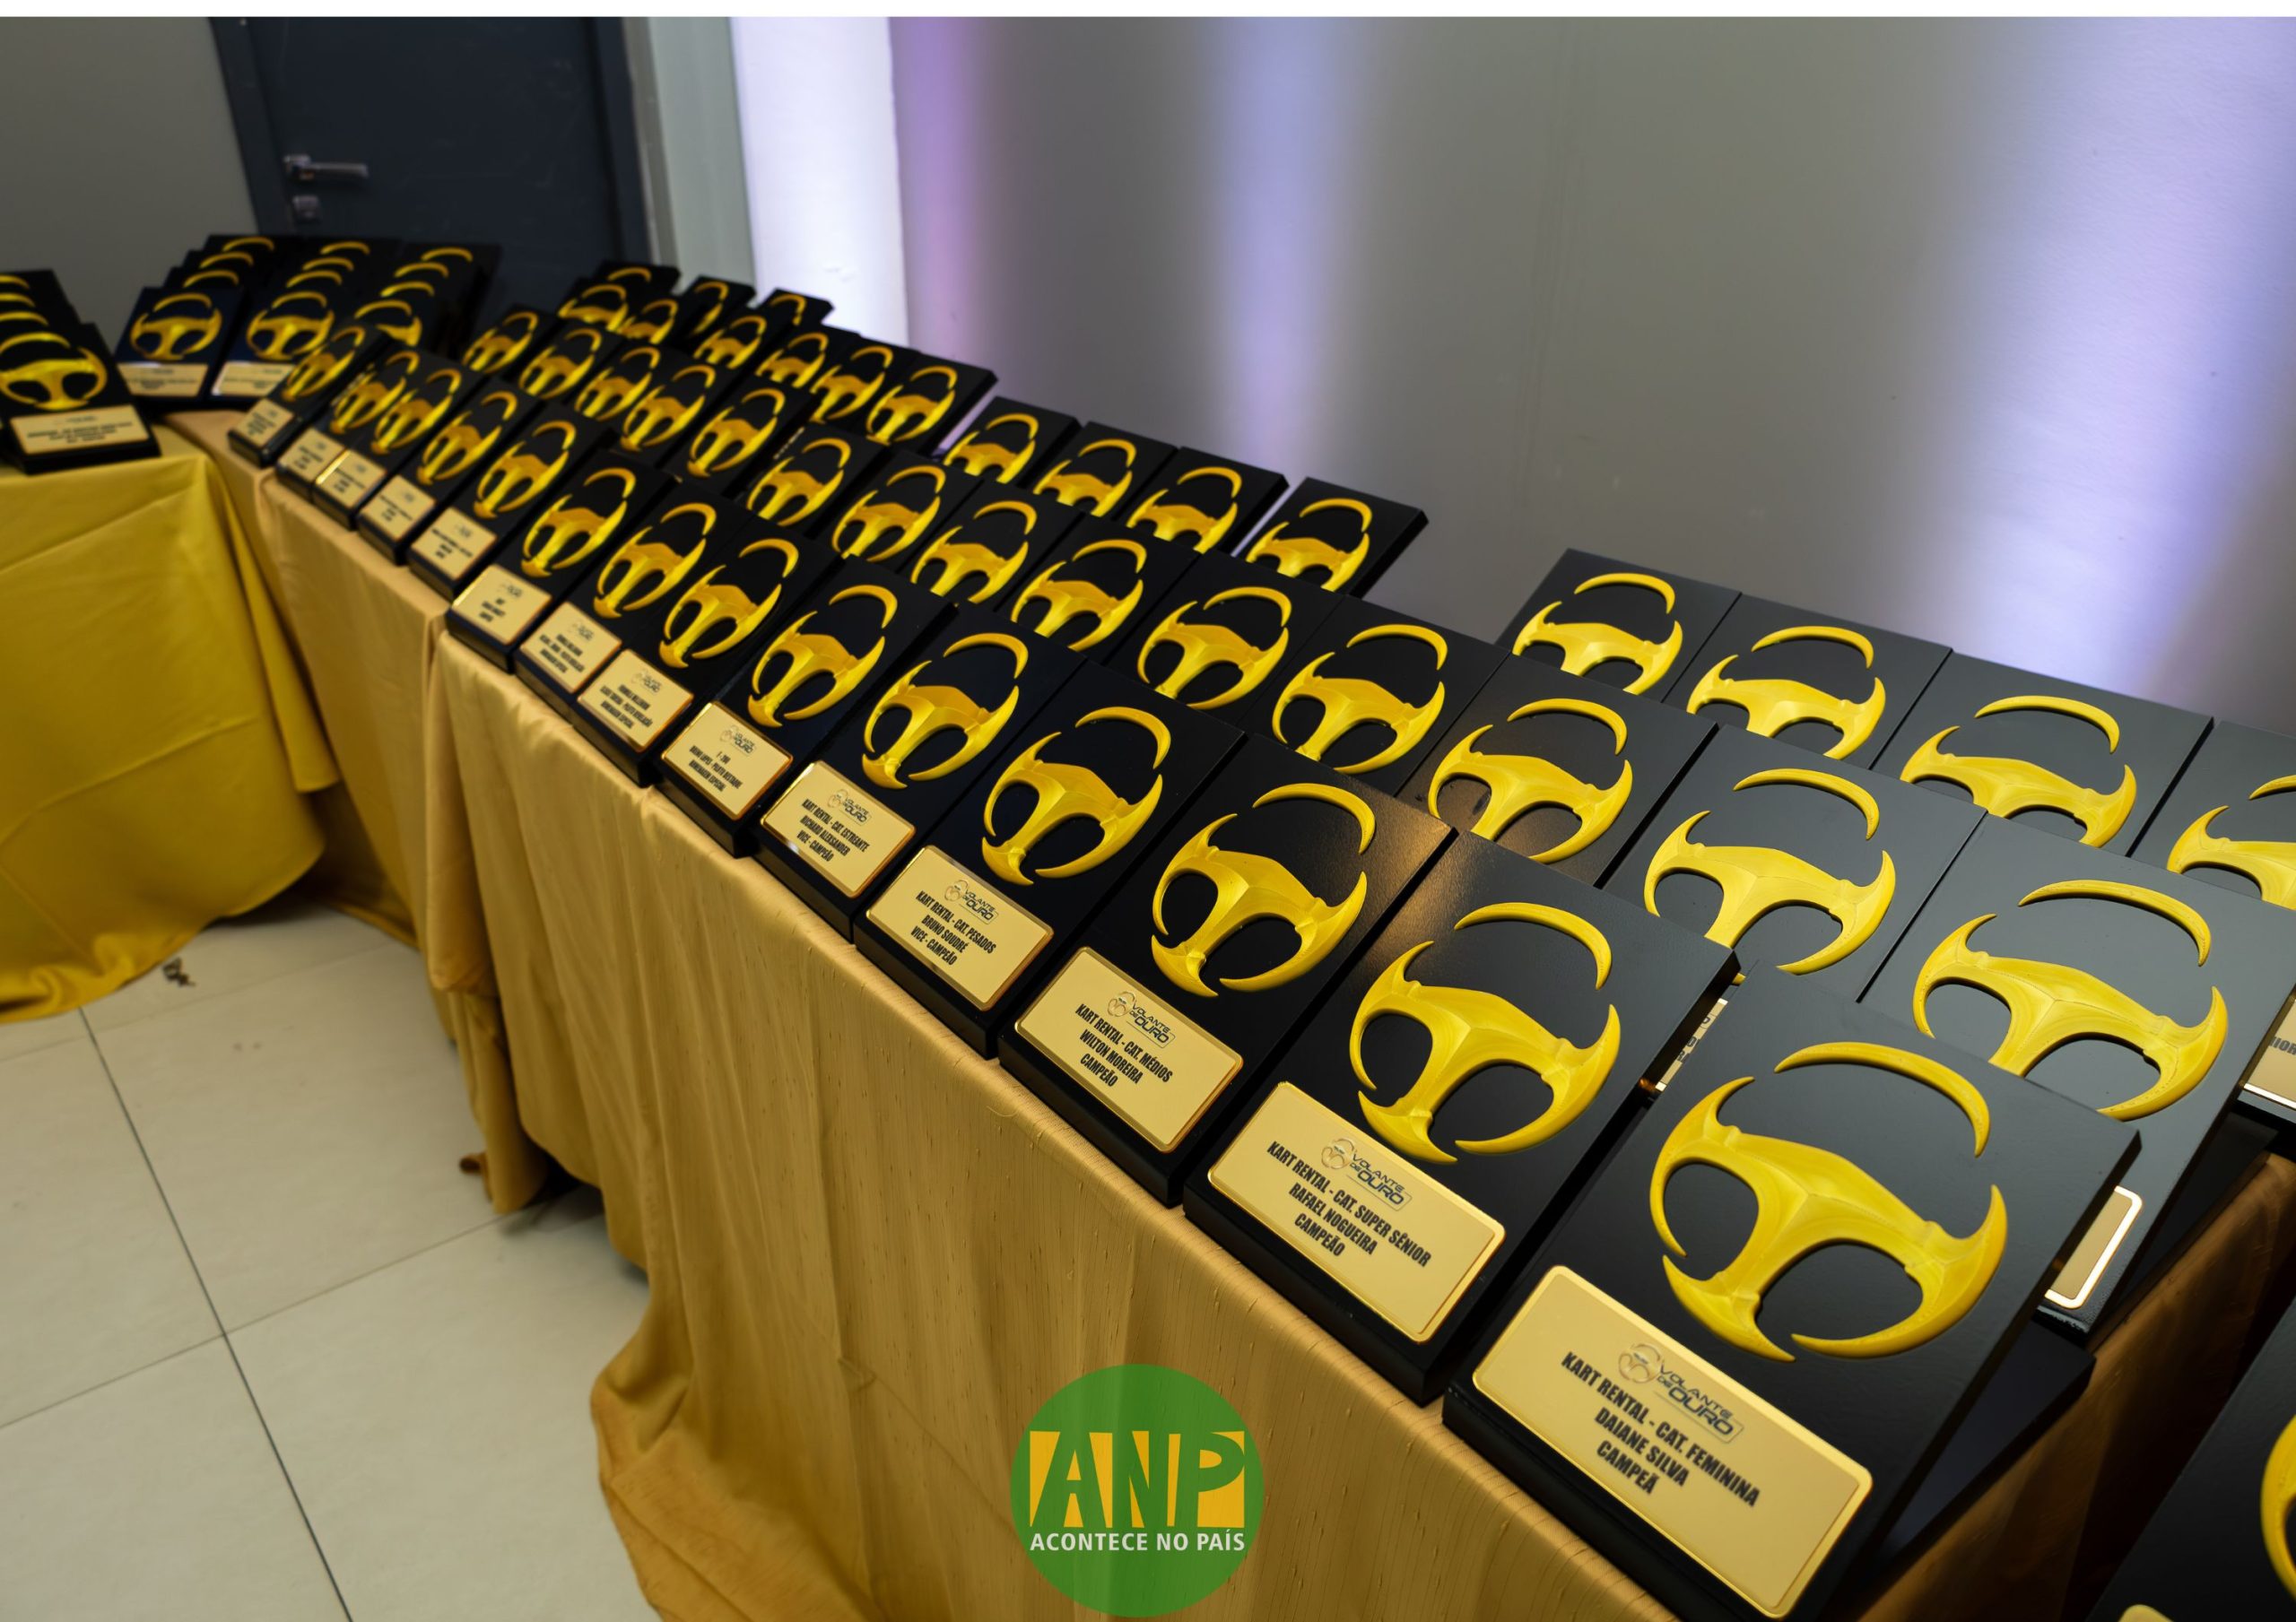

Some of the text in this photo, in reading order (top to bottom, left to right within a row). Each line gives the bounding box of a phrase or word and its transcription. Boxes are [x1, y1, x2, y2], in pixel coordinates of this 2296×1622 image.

[845, 805, 866, 822] OURO
[916, 890, 935, 907] KART
[930, 901, 954, 922] RENTAL
[954, 919, 970, 933] CAT.
[966, 927, 996, 953] PESADOS
[965, 889, 995, 912] VOLANTE
[966, 899, 994, 920] OURO
[910, 925, 927, 941] VICE
[926, 939, 957, 965] CAMPEÃO
[921, 915, 969, 953] BRUNO SOUDRÉ
[1129, 1010, 1169, 1043] DE OURO
[1133, 1003, 1170, 1033] VOLANTE
[1075, 1003, 1099, 1024] KART
[1093, 1018, 1123, 1045] RENTAL
[1124, 1041, 1143, 1059] CAT.
[1139, 1053, 1172, 1082] MÉDIOS
[1080, 1028, 1143, 1084] WILTON MOREIRA
[1080, 1054, 1118, 1087] CAMPEÃO
[1349, 1162, 1404, 1204] DE OURO
[1352, 1154, 1405, 1193] VOLANTE
[1267, 1141, 1297, 1167] KART
[1292, 1159, 1330, 1193] RENTAL
[1333, 1190, 1357, 1212] CAT.
[1354, 1205, 1391, 1237] SUPER
[1388, 1230, 1431, 1267] SÊNIOR
[1289, 1183, 1377, 1254] RAFAEL NOGUEIRA
[1294, 1213, 1344, 1256] CAMPEÃO
[1657, 1375, 1733, 1435] DE OURO
[1660, 1365, 1732, 1420] VOLANTE
[1561, 1352, 1601, 1386] KART
[1596, 1378, 1648, 1423] RENTAL
[1656, 1421, 1688, 1452] CAT.
[1686, 1444, 1759, 1506] FEMININA
[1595, 1408, 1688, 1486] DAIANE SILVA
[1596, 1441, 1658, 1494] CAMPEÃ
